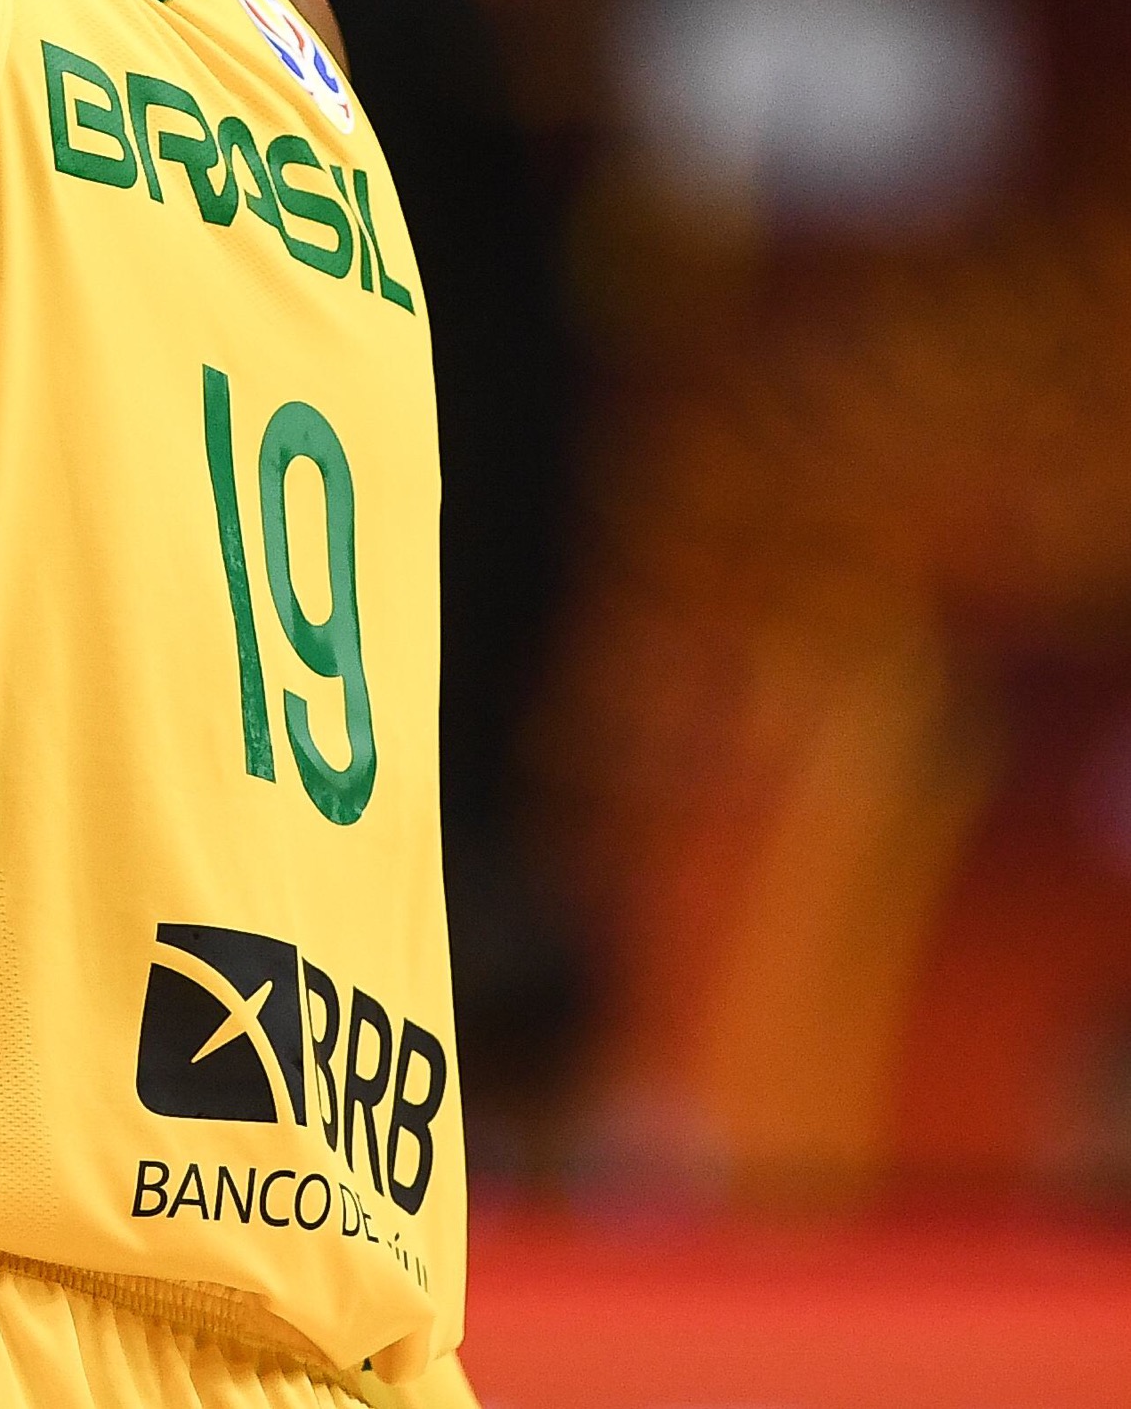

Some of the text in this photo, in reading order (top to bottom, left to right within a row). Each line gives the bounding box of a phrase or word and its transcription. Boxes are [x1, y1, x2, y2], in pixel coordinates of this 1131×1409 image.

[41, 40, 416, 316] BRASIL
[202, 363, 377, 826] 19
[131, 1160, 331, 1231] BANCO
[302, 956, 447, 1215] BRB
